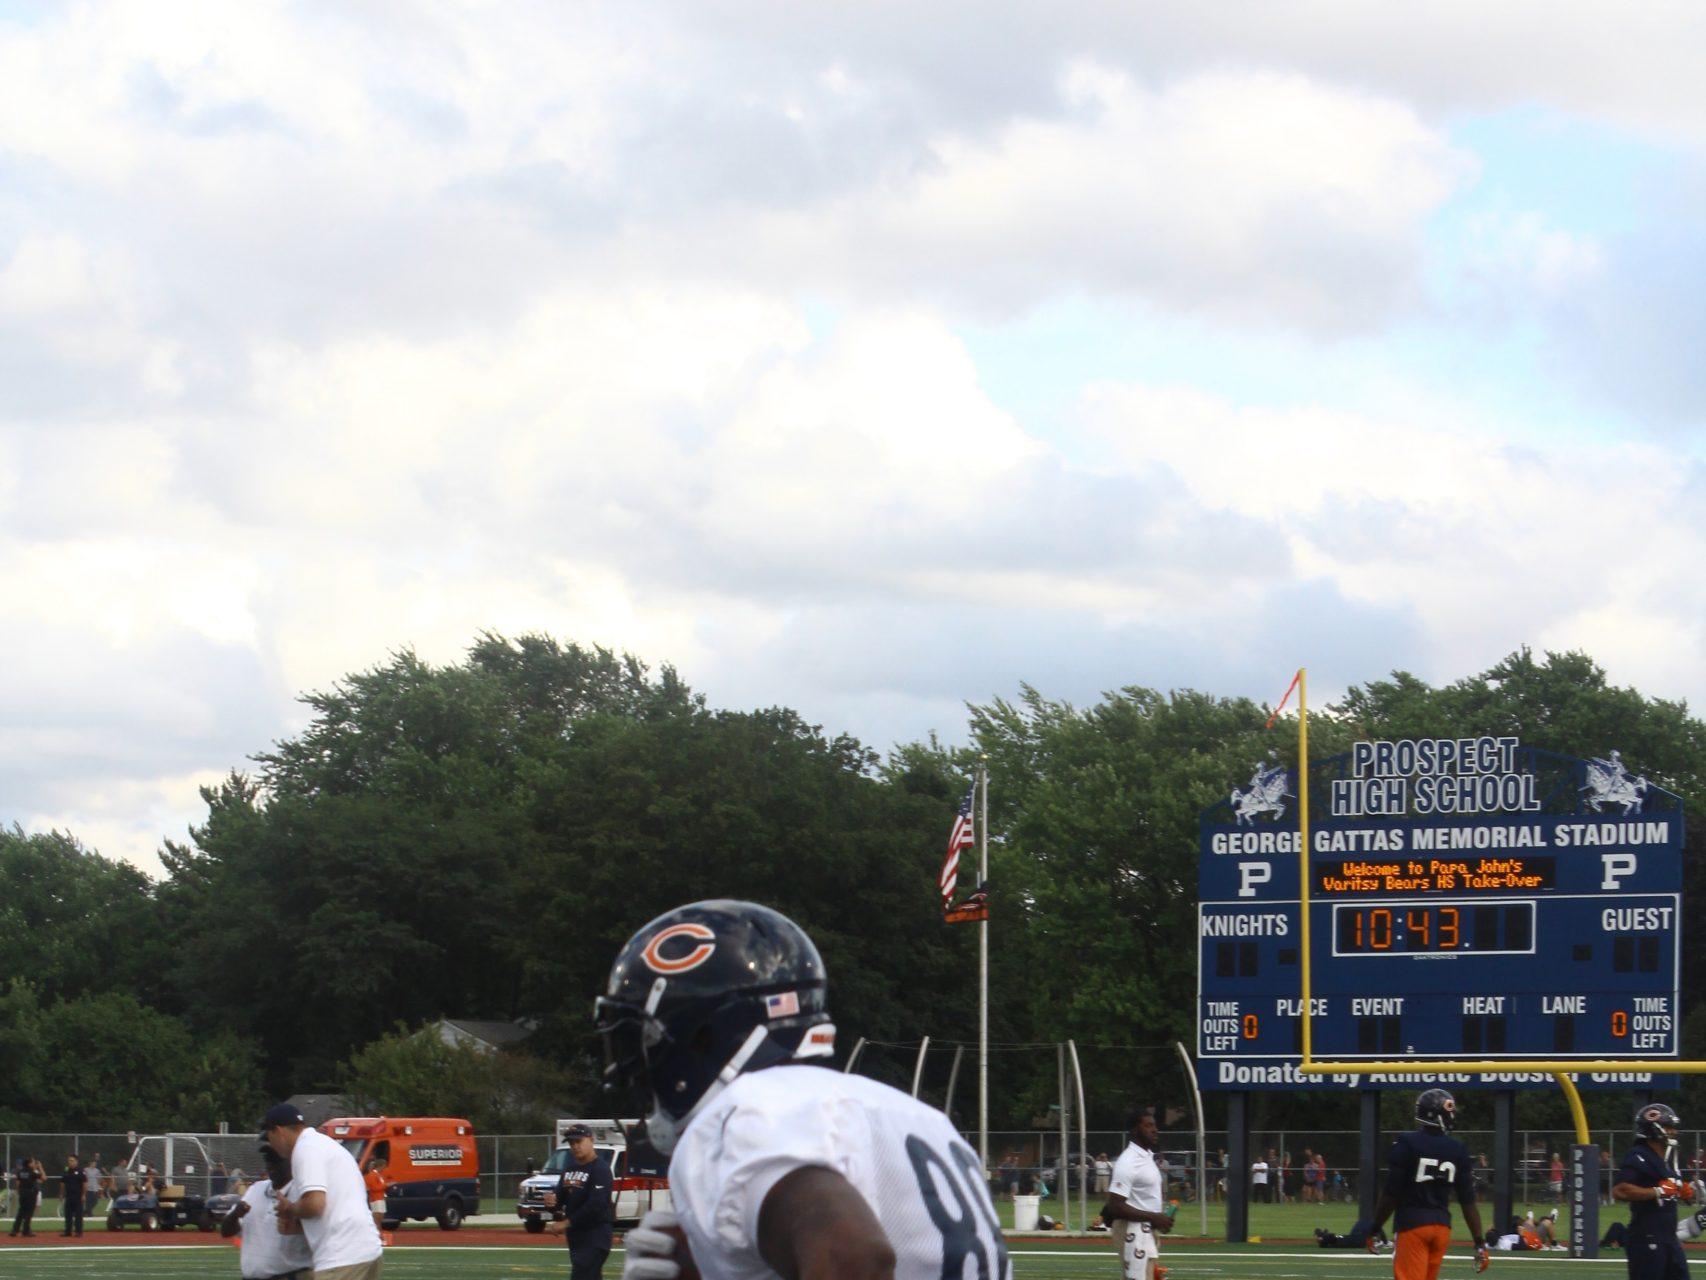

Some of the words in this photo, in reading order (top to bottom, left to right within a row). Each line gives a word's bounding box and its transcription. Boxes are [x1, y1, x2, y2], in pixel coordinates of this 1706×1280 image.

[1353, 737, 1519, 778] PROSPECT
[1331, 778, 1407, 816] HIGH
[1414, 774, 1541, 814] SCHOOL
[1211, 832, 1302, 854] GEORGE
[1314, 829, 1404, 852] GATTAS
[1412, 826, 1547, 850] MEMORIAL
[1554, 822, 1669, 847] STADIUM
[1343, 862, 1400, 876] Welcome
[1407, 861, 1423, 875] to
[1430, 860, 1468, 875] Papa
[1476, 859, 1522, 873] John's
[1601, 854, 1637, 889] P
[1238, 862, 1272, 897] P
[1385, 876, 1430, 890] Bears
[1437, 875, 1455, 888] HS
[1463, 873, 1542, 888] Take-Over
[1201, 914, 1289, 936] KNIGHTS
[1602, 908, 1673, 931] GUEST
[1207, 1002, 1239, 1017] TIME
[1276, 998, 1328, 1017] PLACE
[1351, 997, 1404, 1016] EVENT
[1462, 997, 1505, 1014] HEAT
[1542, 996, 1586, 1014] LANE
[1632, 998, 1667, 1013] TIME
[1203, 1019, 1239, 1034] OUTS
[1243, 1014, 1258, 1039] 0
[1612, 1010, 1627, 1037] 0
[1633, 1016, 1671, 1031] OUTS
[1206, 1036, 1238, 1051] LEFT
[1632, 1033, 1667, 1049] LEFT
[408, 1149, 464, 1159] SUPERIOR
[1573, 1149, 1584, 1258] PROSPECT
